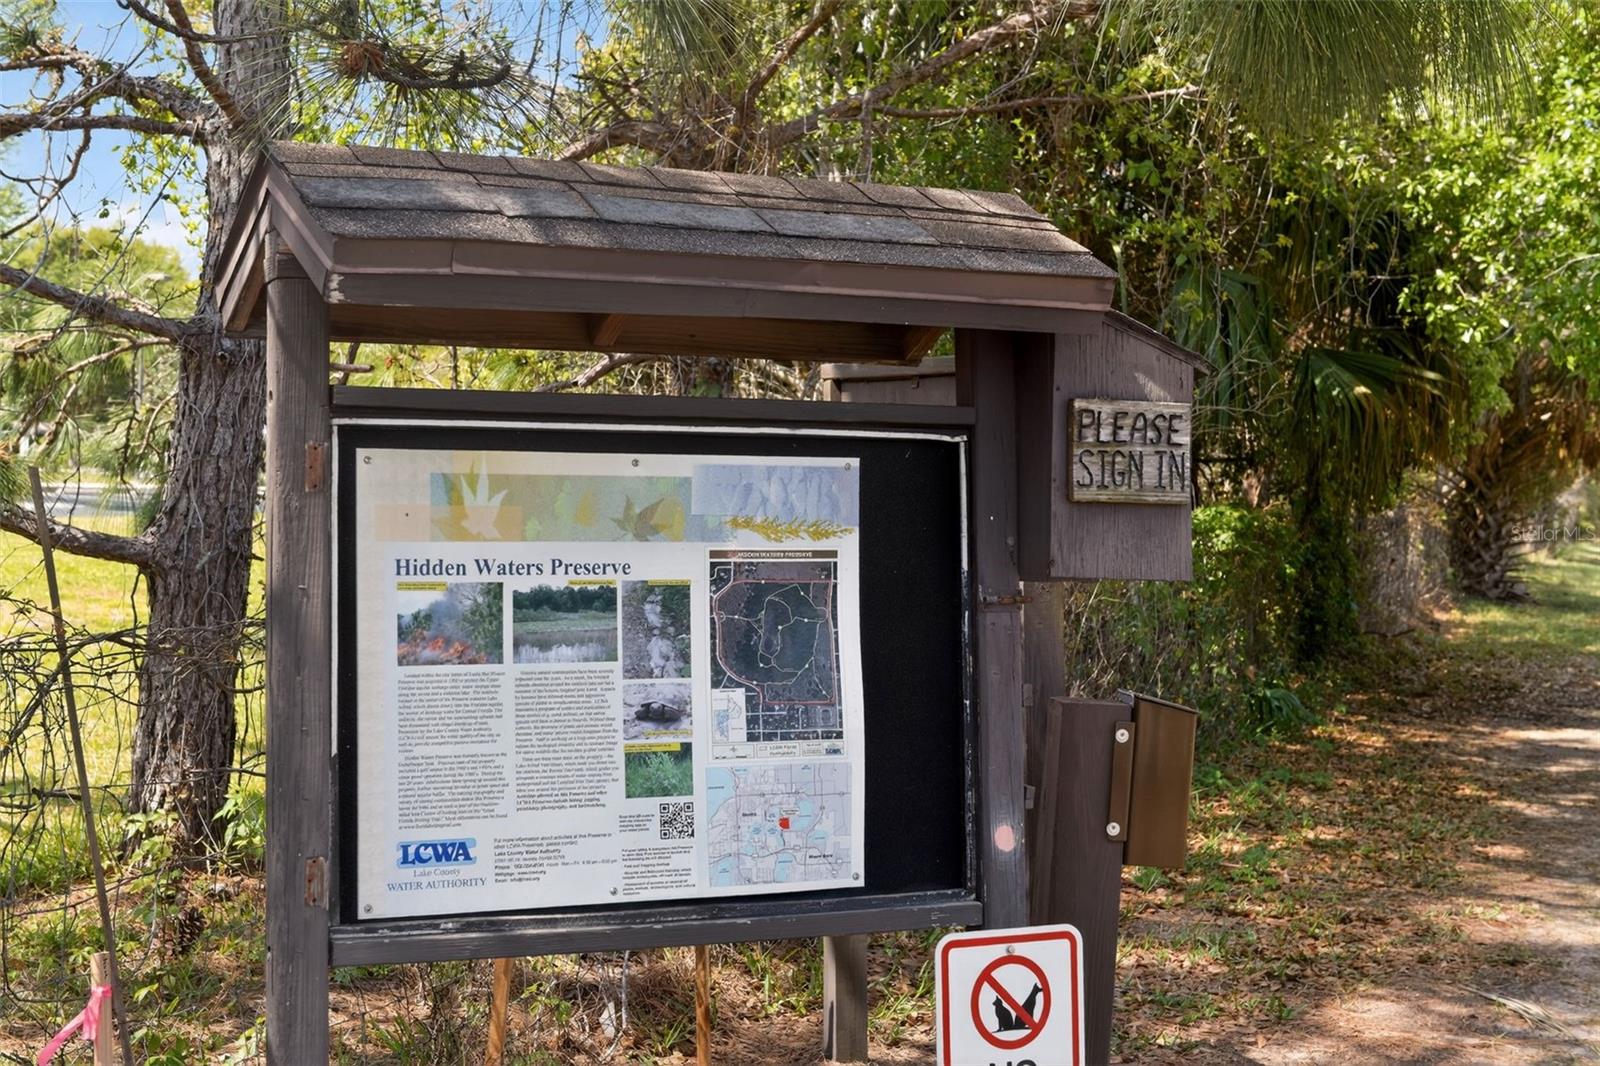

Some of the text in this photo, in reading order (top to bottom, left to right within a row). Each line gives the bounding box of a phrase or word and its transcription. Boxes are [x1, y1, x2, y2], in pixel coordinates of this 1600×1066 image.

[1077, 408, 1186, 446] PLEASE
[1076, 448, 1187, 490] SIGN IN
[395, 558, 632, 576] Hidden Waters Preserve
[400, 841, 473, 865] LCWA
[433, 868, 461, 877] County
[387, 878, 487, 892] WATER AUTHORITY
